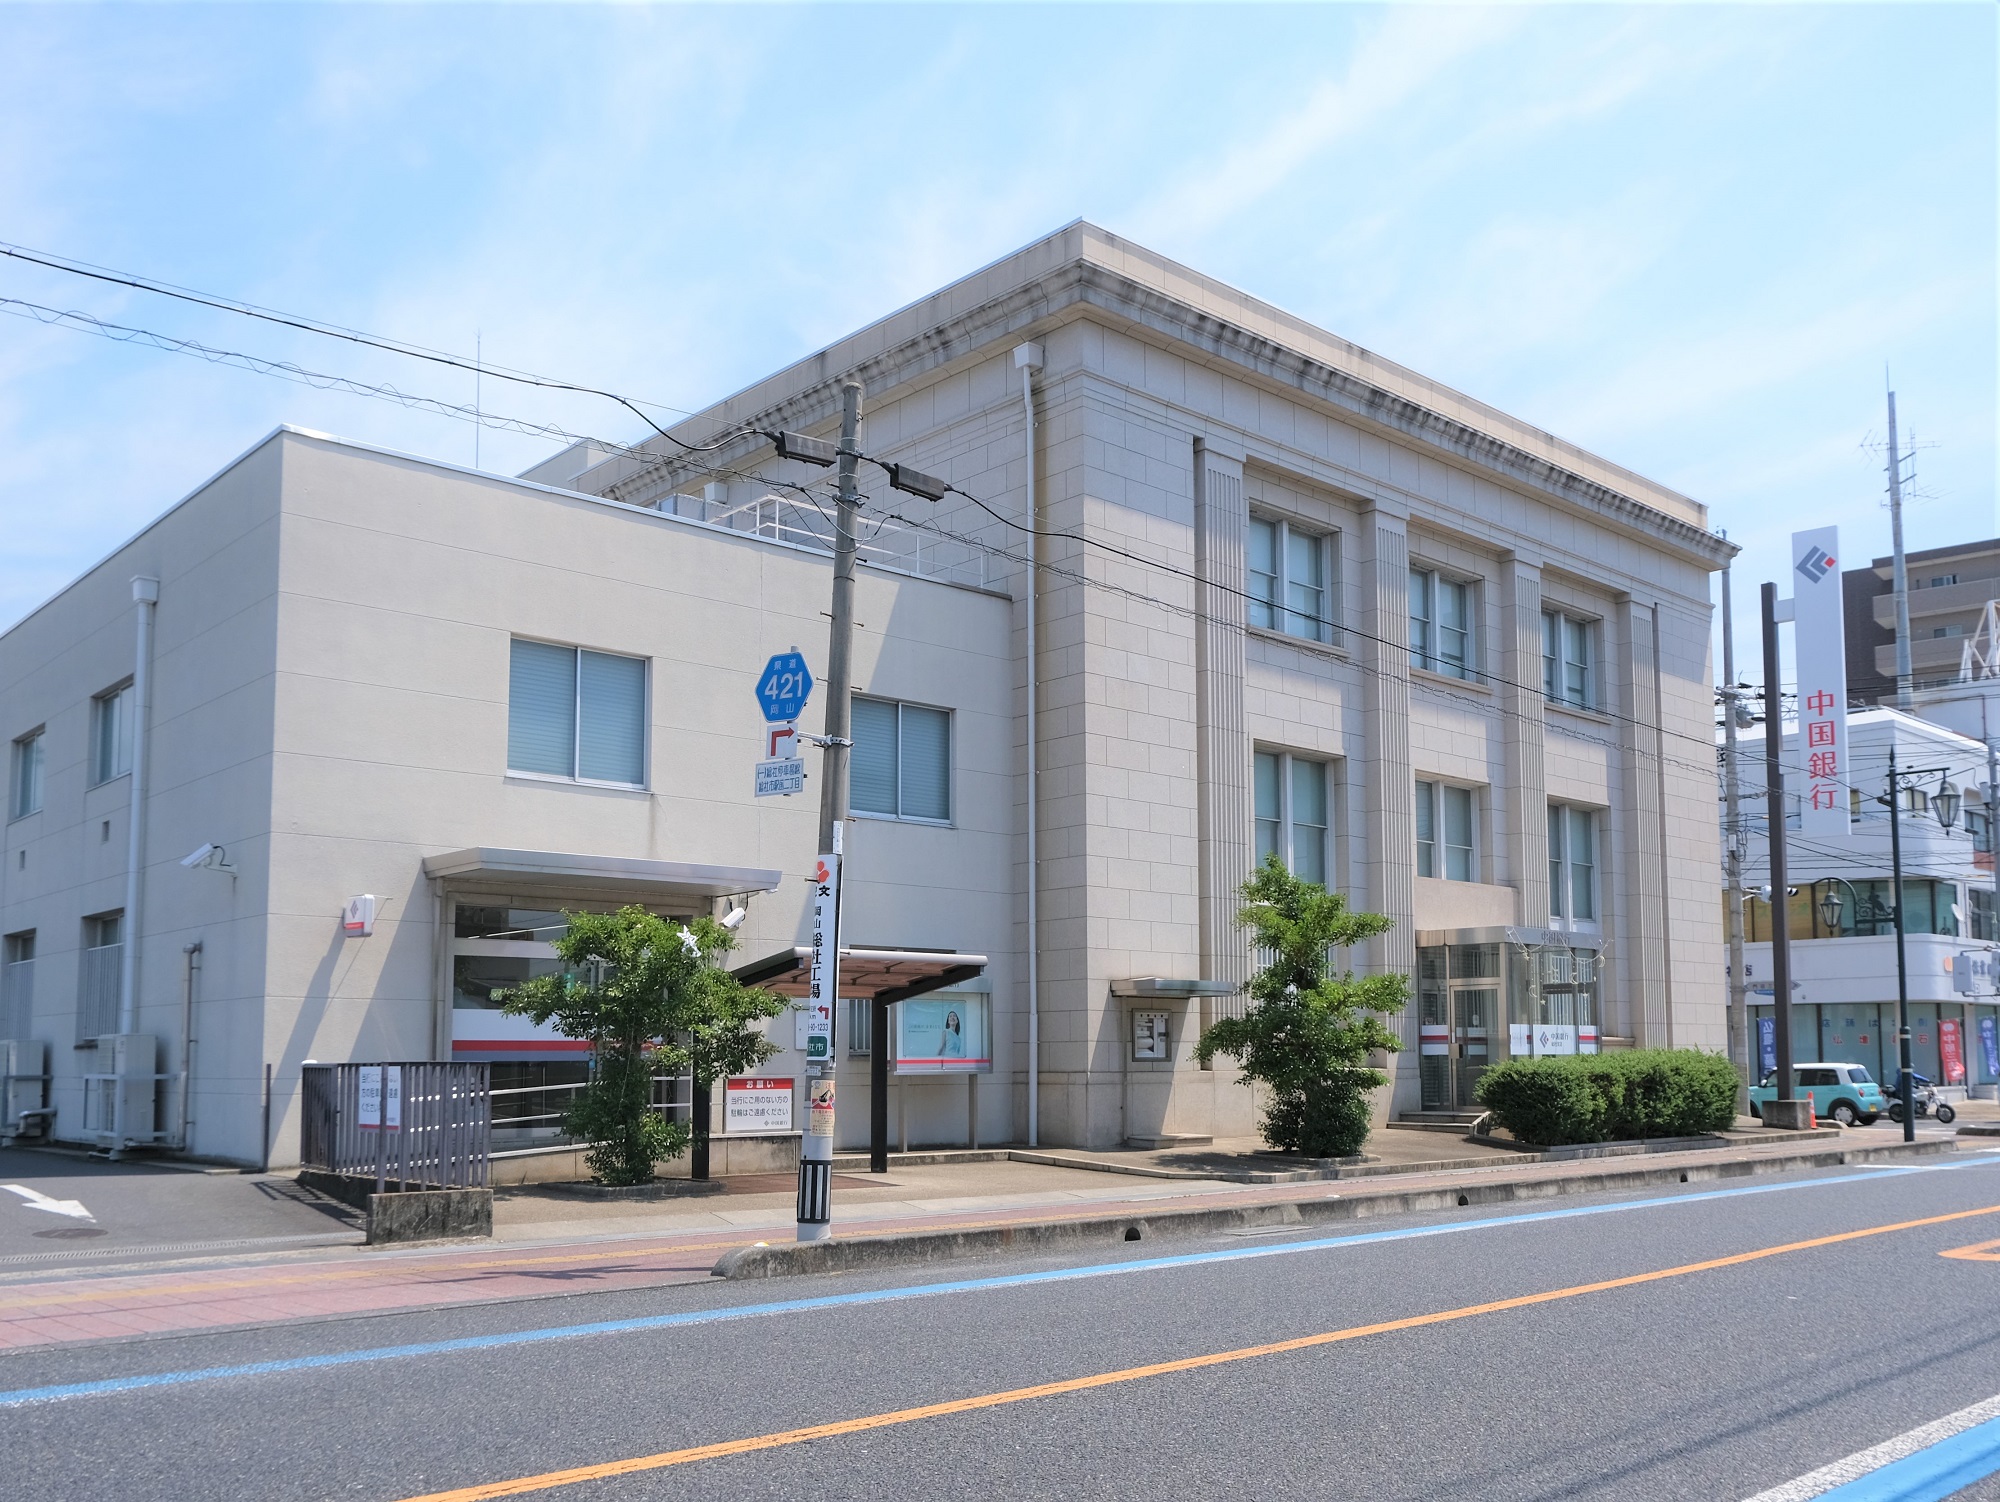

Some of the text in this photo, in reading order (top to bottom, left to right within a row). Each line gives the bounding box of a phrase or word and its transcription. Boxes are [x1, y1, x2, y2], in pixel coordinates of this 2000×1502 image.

[774, 658, 796, 670] 県道
[764, 671, 803, 700] 421
[770, 702, 795, 715] 岡山
[1807, 689, 1839, 811] 中国銀行
[808, 1023, 829, 1032] -90-1233
[746, 1080, 774, 1089] お願い
[731, 1096, 789, 1105] 当行にご用のない方の
[731, 1108, 789, 1117] 駐輪はご遠慮ください
